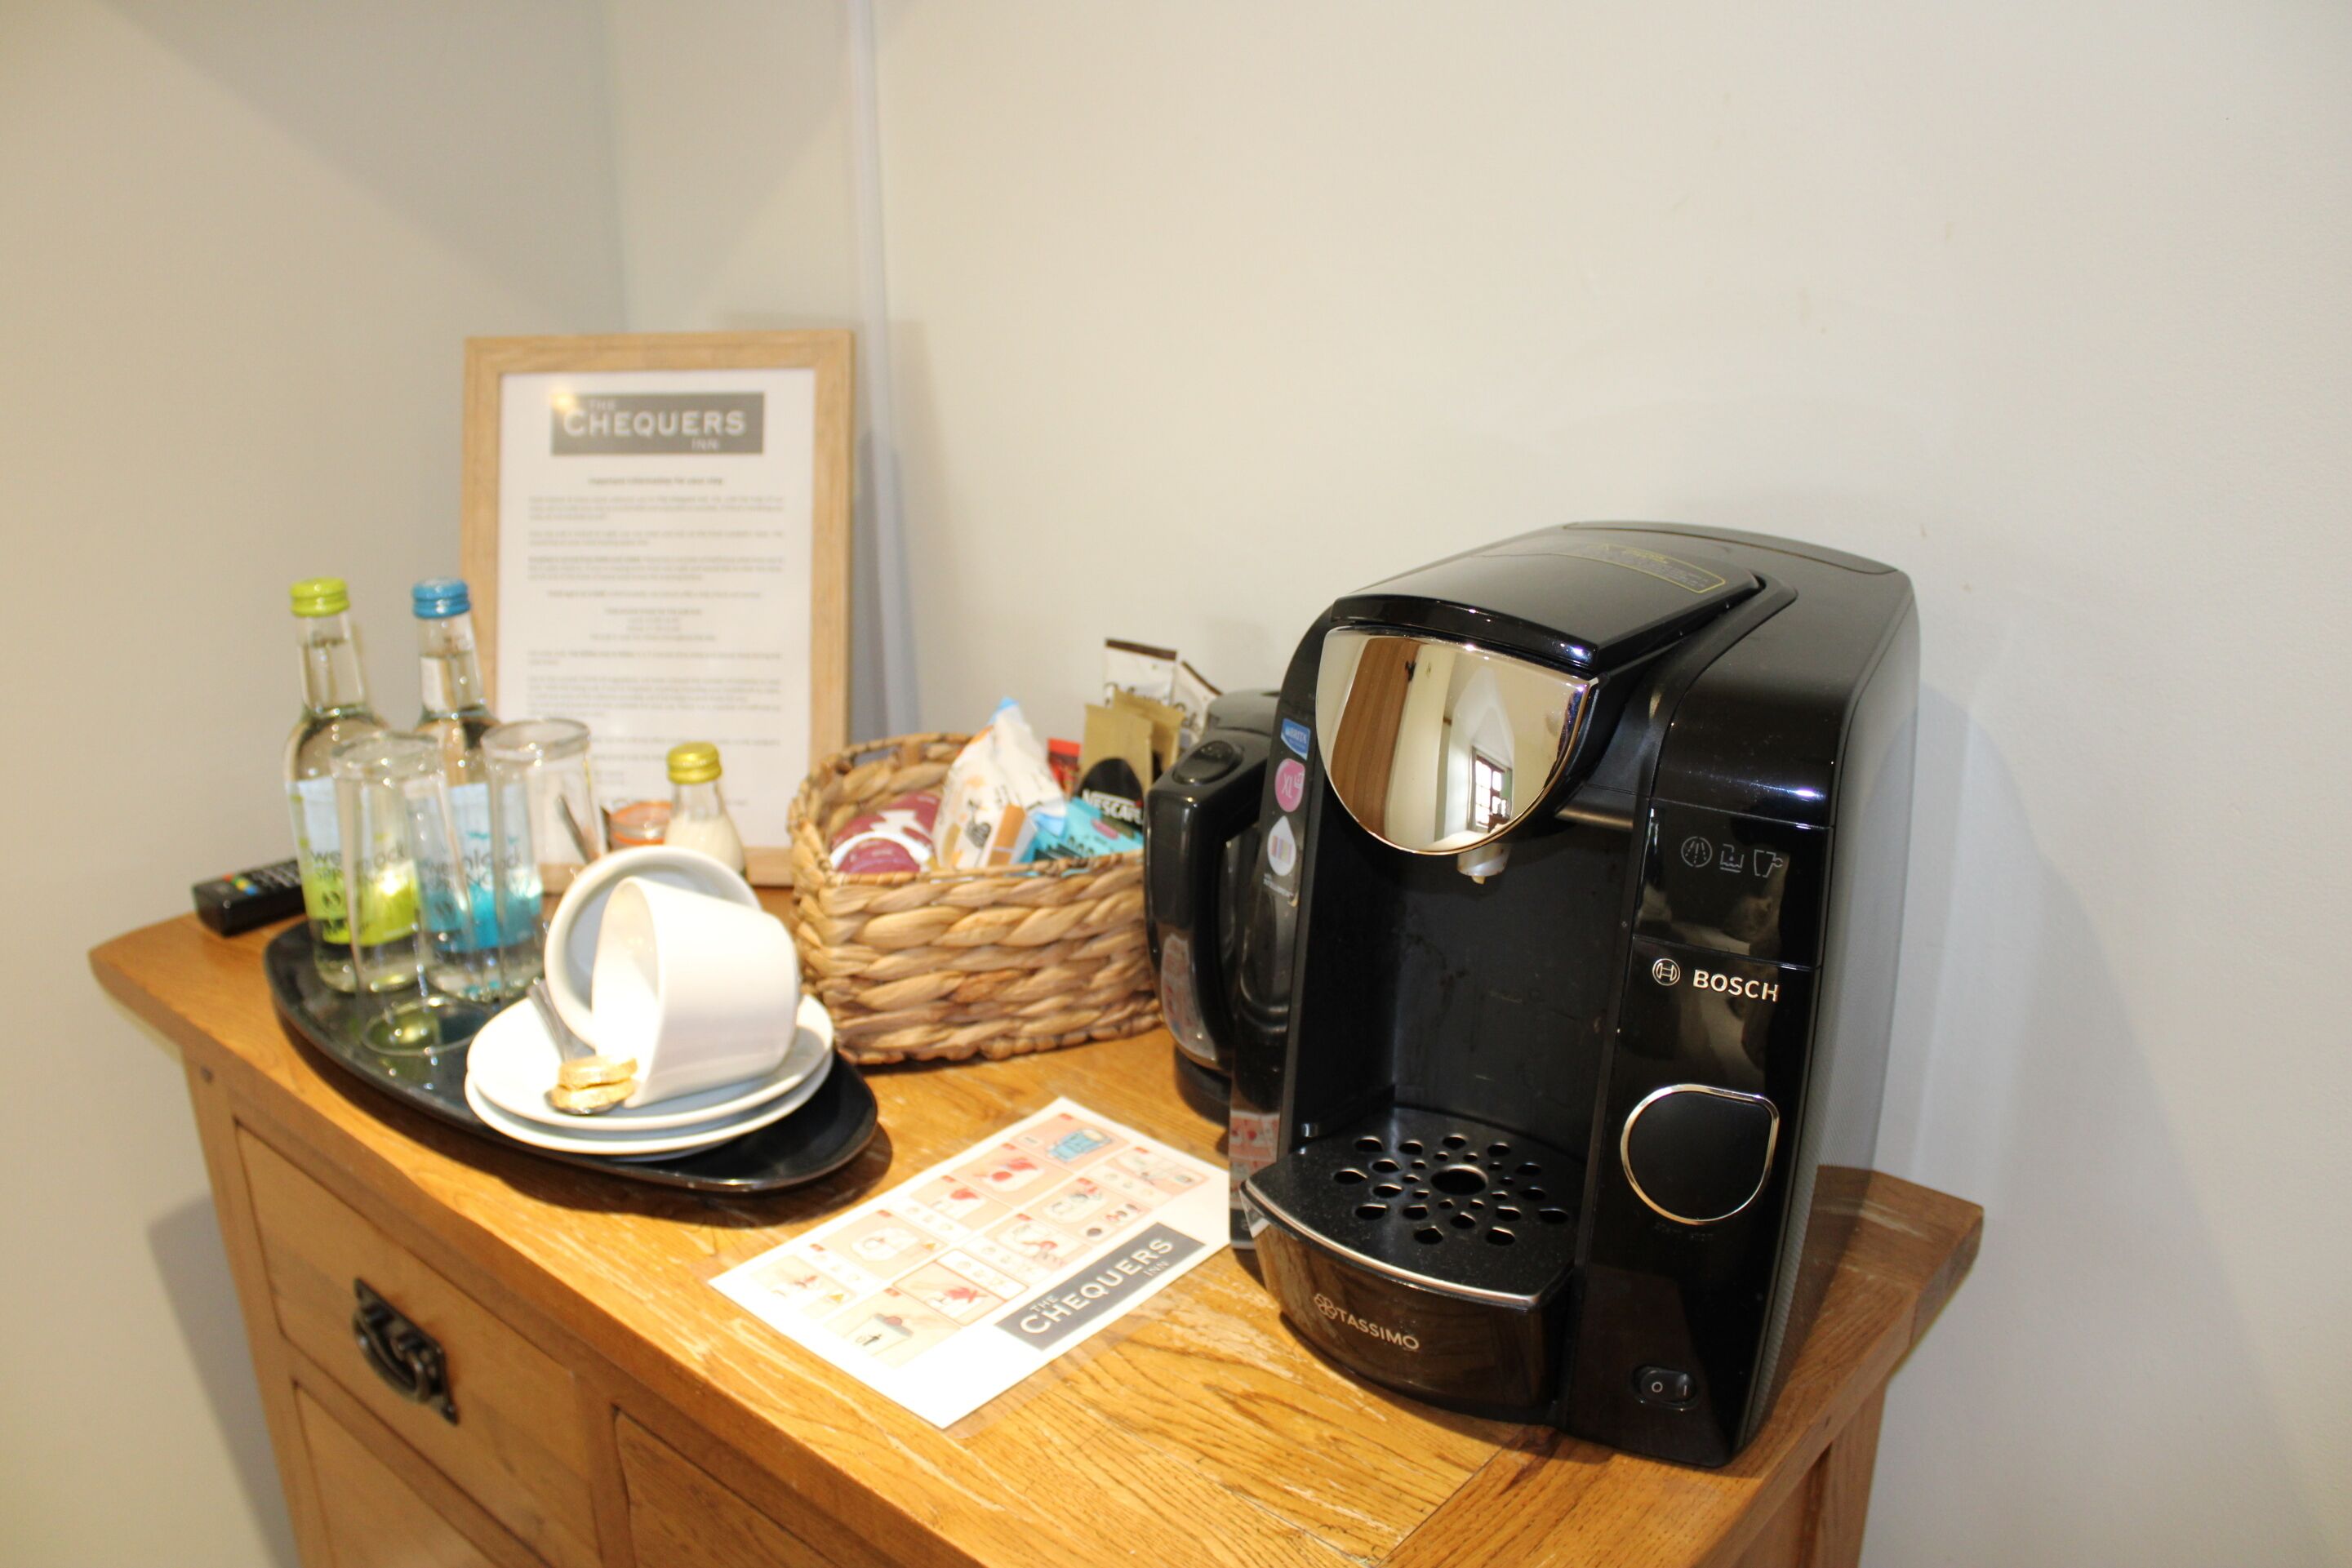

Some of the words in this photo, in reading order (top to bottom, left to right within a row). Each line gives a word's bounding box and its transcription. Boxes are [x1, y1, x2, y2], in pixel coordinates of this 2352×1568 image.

[563, 410, 747, 438] CHEQUERS
[692, 438, 720, 451] INN
[1692, 969, 1780, 1002] BOSCH
[1144, 1260, 1170, 1277] INN
[1020, 1238, 1174, 1334] CHEQUERS
[1029, 1295, 1059, 1313] THE
[1336, 1307, 1420, 1350] TASSIMO
